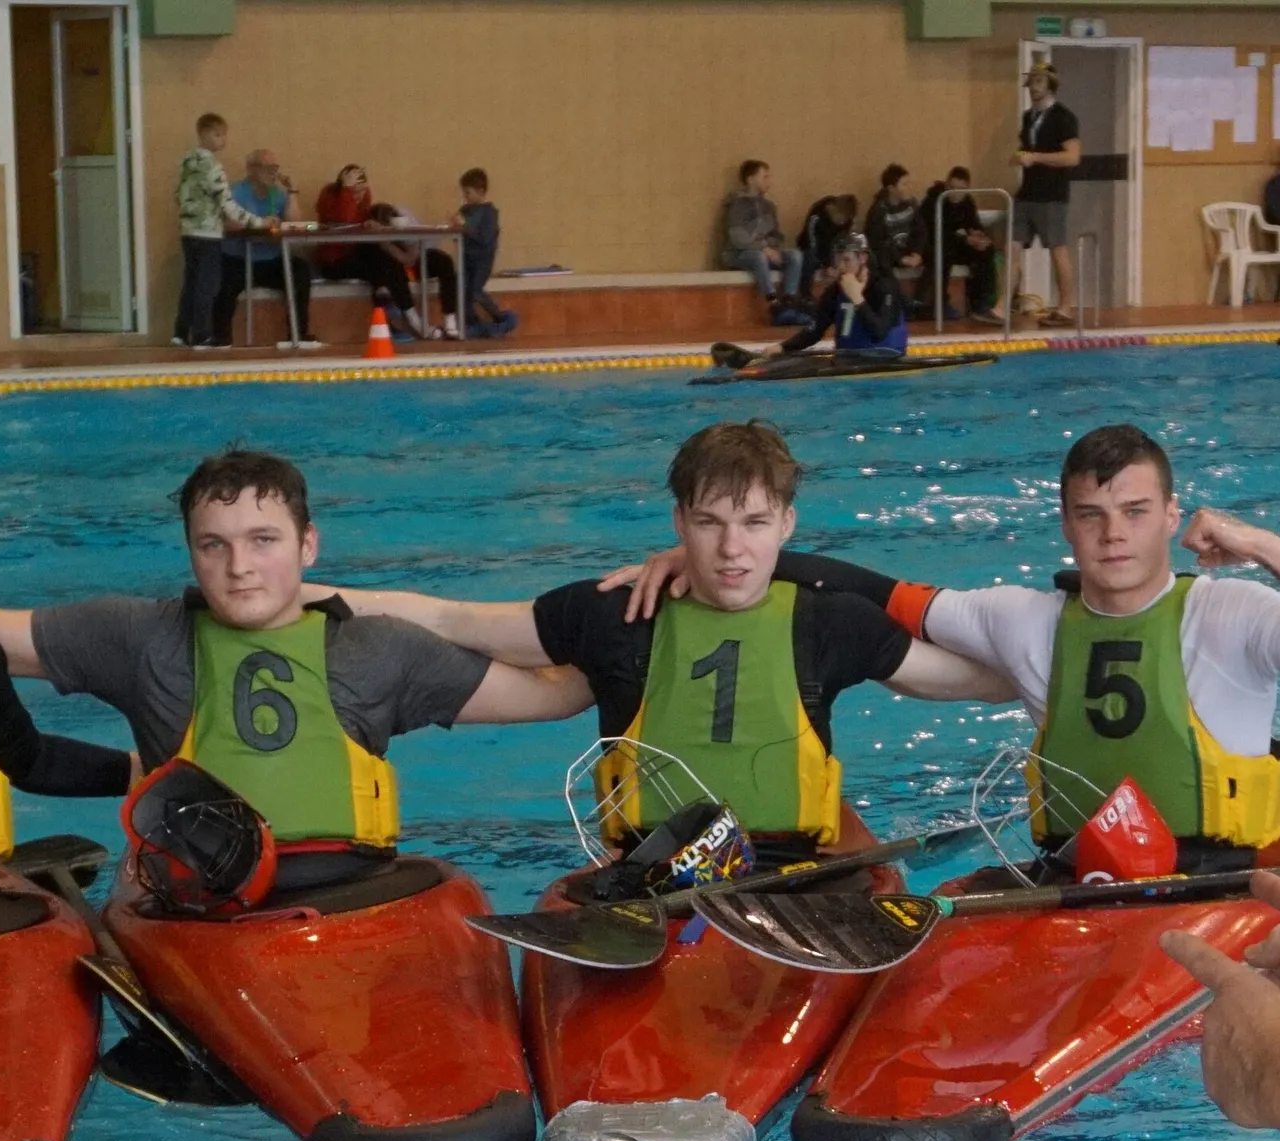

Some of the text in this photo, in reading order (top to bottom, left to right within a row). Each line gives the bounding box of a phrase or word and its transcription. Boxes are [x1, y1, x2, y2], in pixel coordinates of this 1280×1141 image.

[233, 650, 298, 752] 6
[690, 639, 740, 743] 1
[1084, 640, 1147, 739] 5
